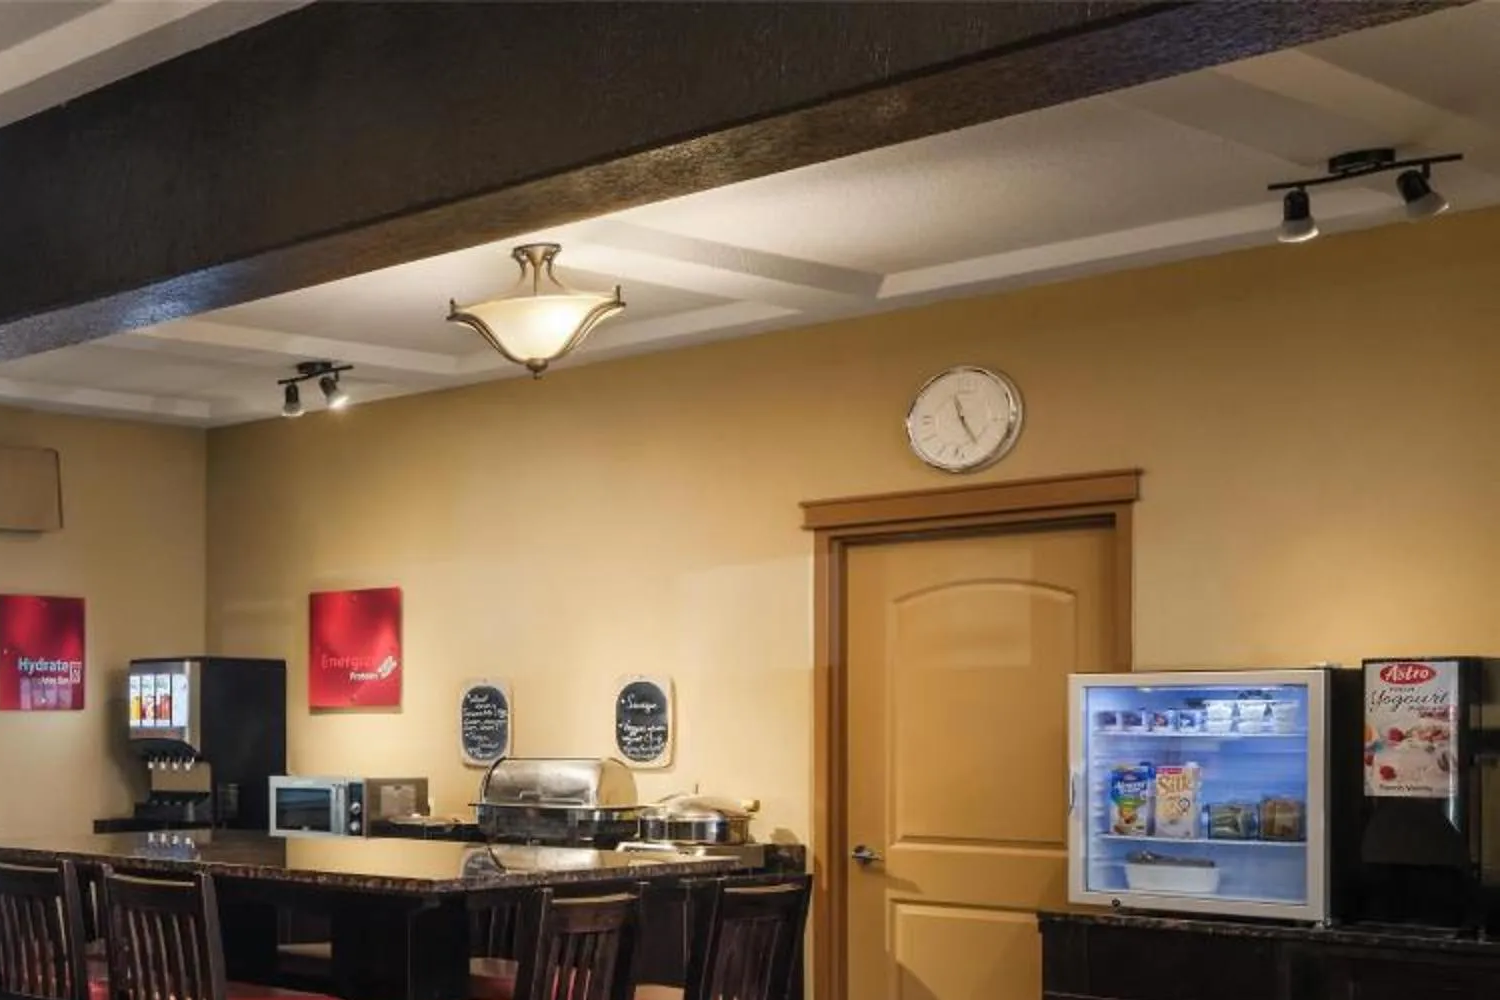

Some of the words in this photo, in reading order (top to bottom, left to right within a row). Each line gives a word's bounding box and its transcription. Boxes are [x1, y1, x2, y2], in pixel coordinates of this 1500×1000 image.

[18, 656, 69, 675] Hydrate
[1385, 664, 1430, 682] Astro
[1369, 688, 1449, 712] Yogourt
[1157, 774, 1190, 793] Silk
